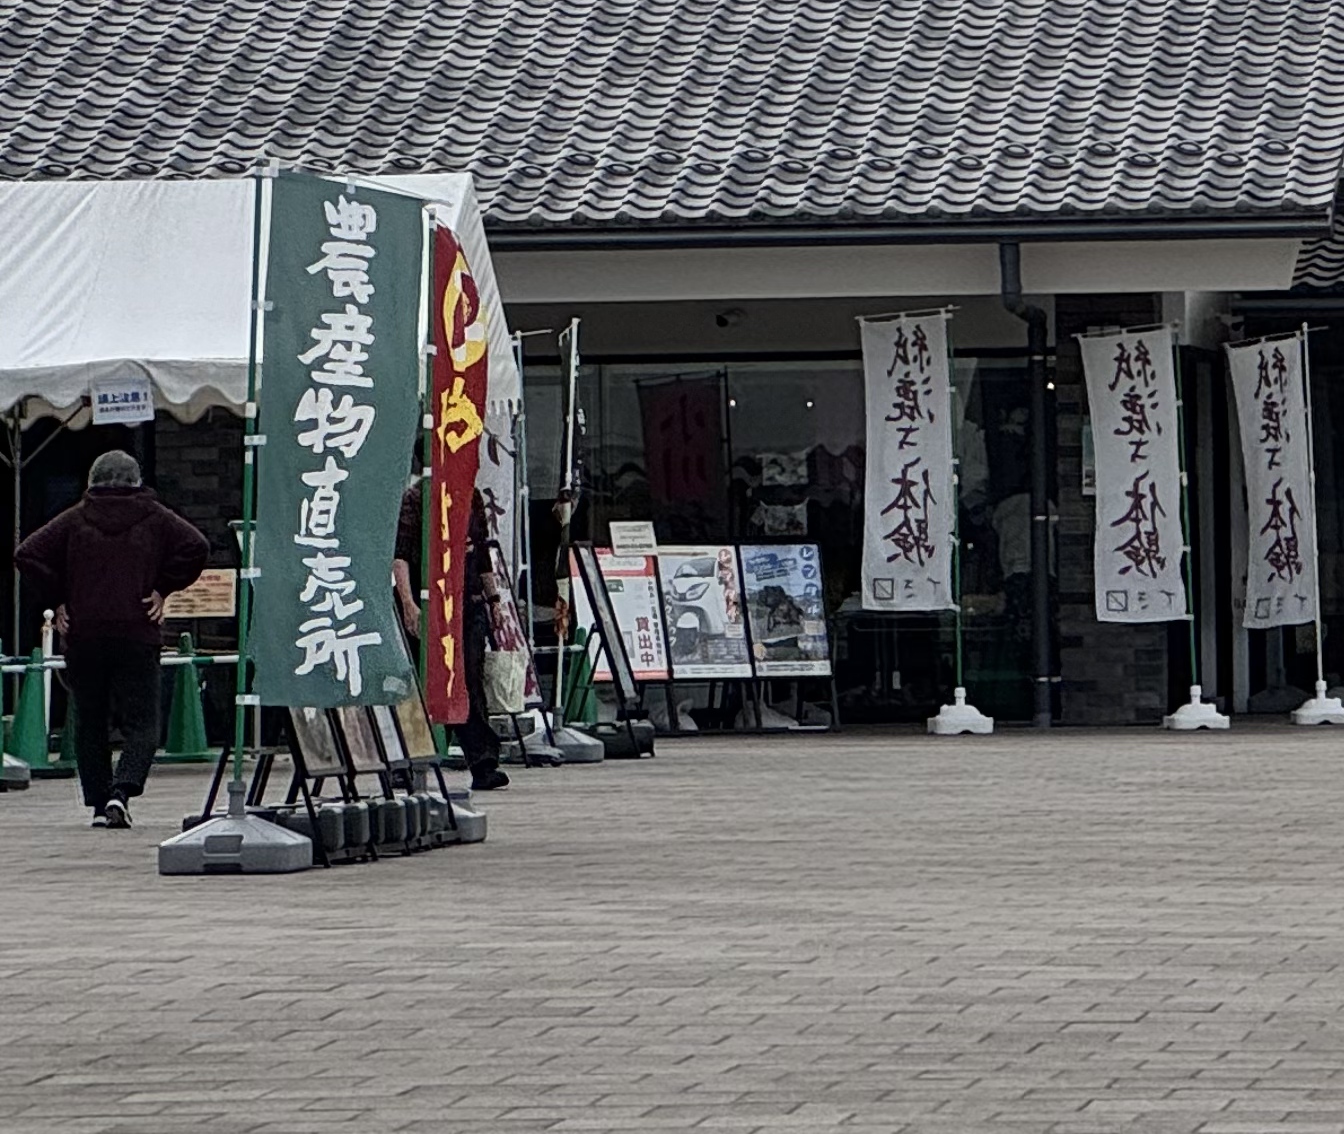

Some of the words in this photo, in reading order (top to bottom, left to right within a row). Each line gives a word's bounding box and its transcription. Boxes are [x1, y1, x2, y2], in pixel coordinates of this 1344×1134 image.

[294, 195, 382, 697] 農産物直売所
